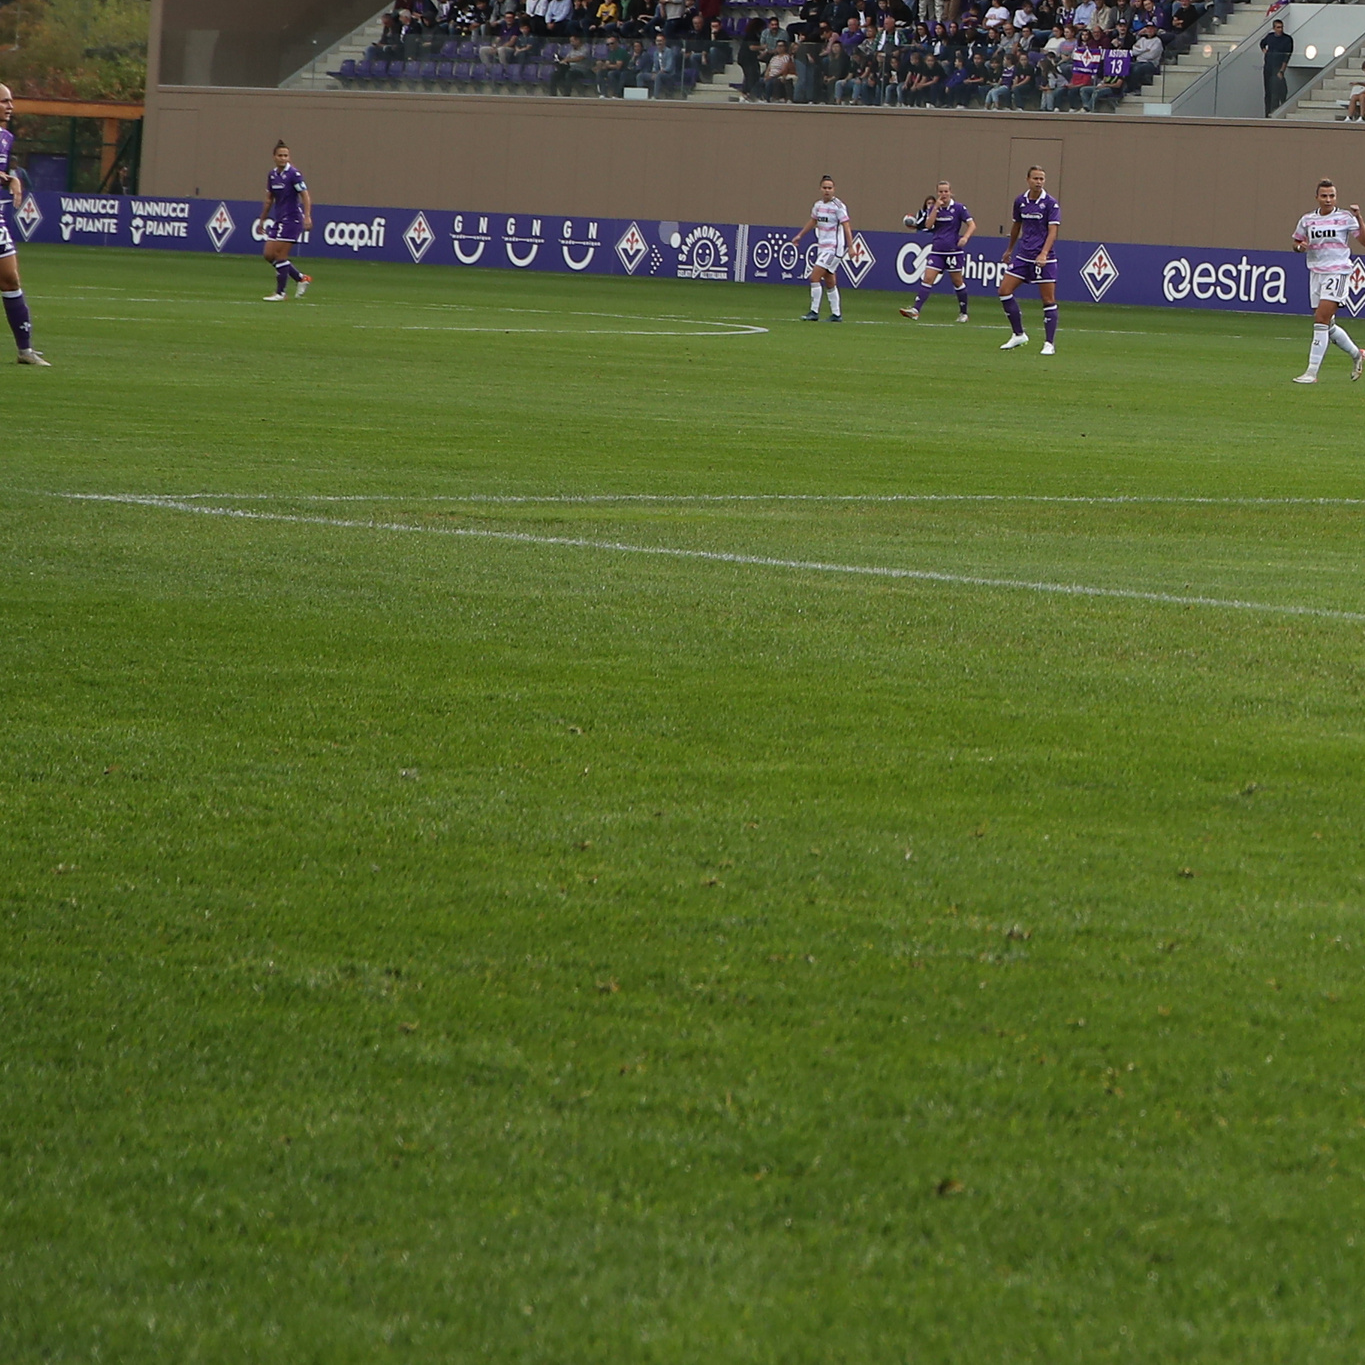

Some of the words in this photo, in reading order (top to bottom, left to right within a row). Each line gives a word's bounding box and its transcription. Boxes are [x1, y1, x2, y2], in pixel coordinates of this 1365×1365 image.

[1110, 59, 1123, 74] 13
[60, 197, 120, 215] VANNUCCI
[130, 200, 190, 218] VANNUCCI
[75, 216, 118, 234] PIANTE
[145, 220, 188, 237] PIANTE
[324, 217, 387, 252] coop.fi
[678, 225, 729, 264] SAMMONTANA
[1192, 255, 1287, 304] estra
[1325, 277, 1339, 291] 21
